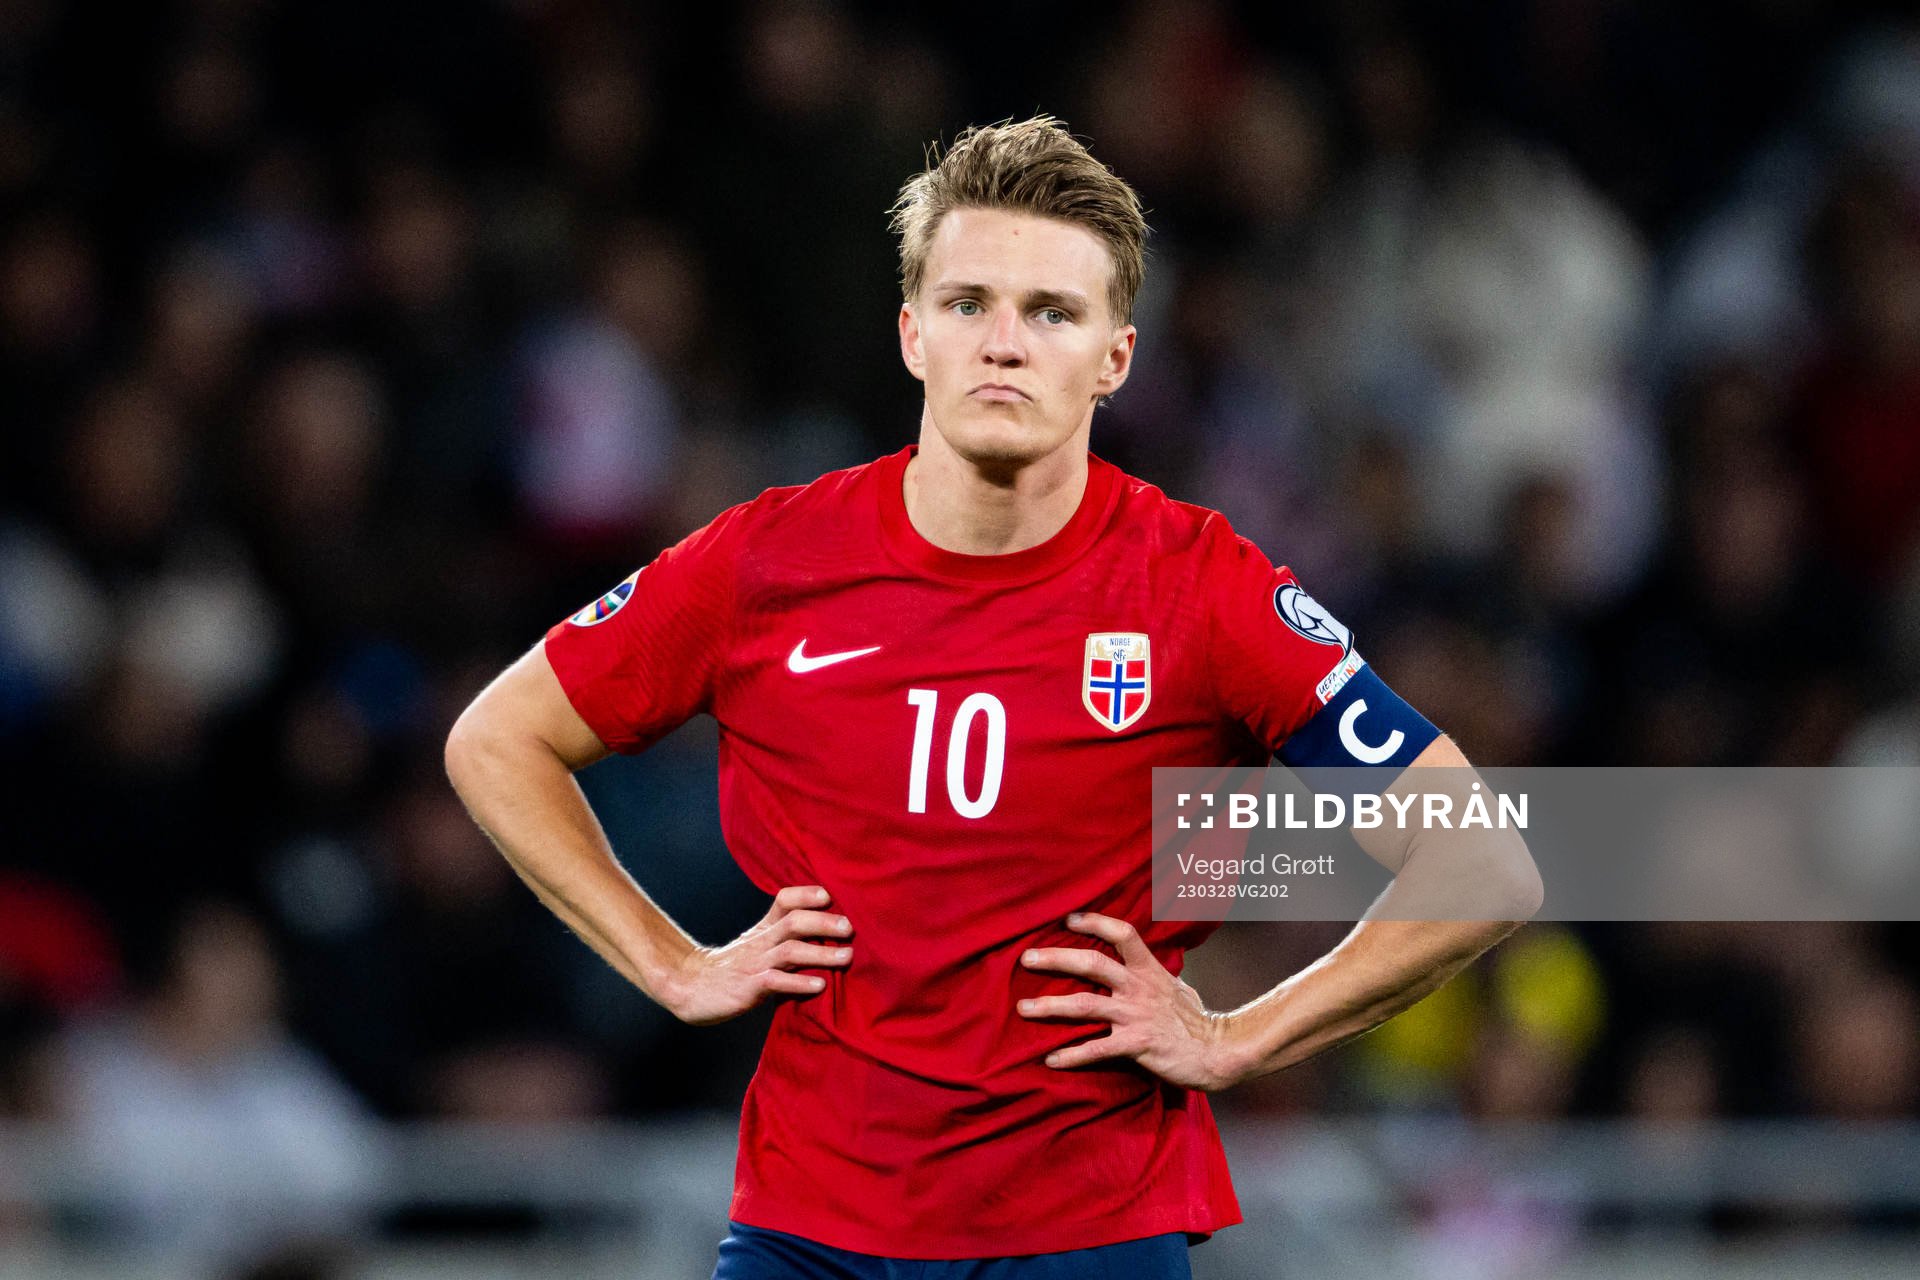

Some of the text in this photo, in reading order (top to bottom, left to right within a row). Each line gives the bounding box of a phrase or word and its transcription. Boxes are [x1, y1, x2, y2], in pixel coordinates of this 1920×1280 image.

[1318, 671, 1337, 695] UEFA
[908, 688, 1006, 819] 10
[1339, 698, 1405, 764] C
